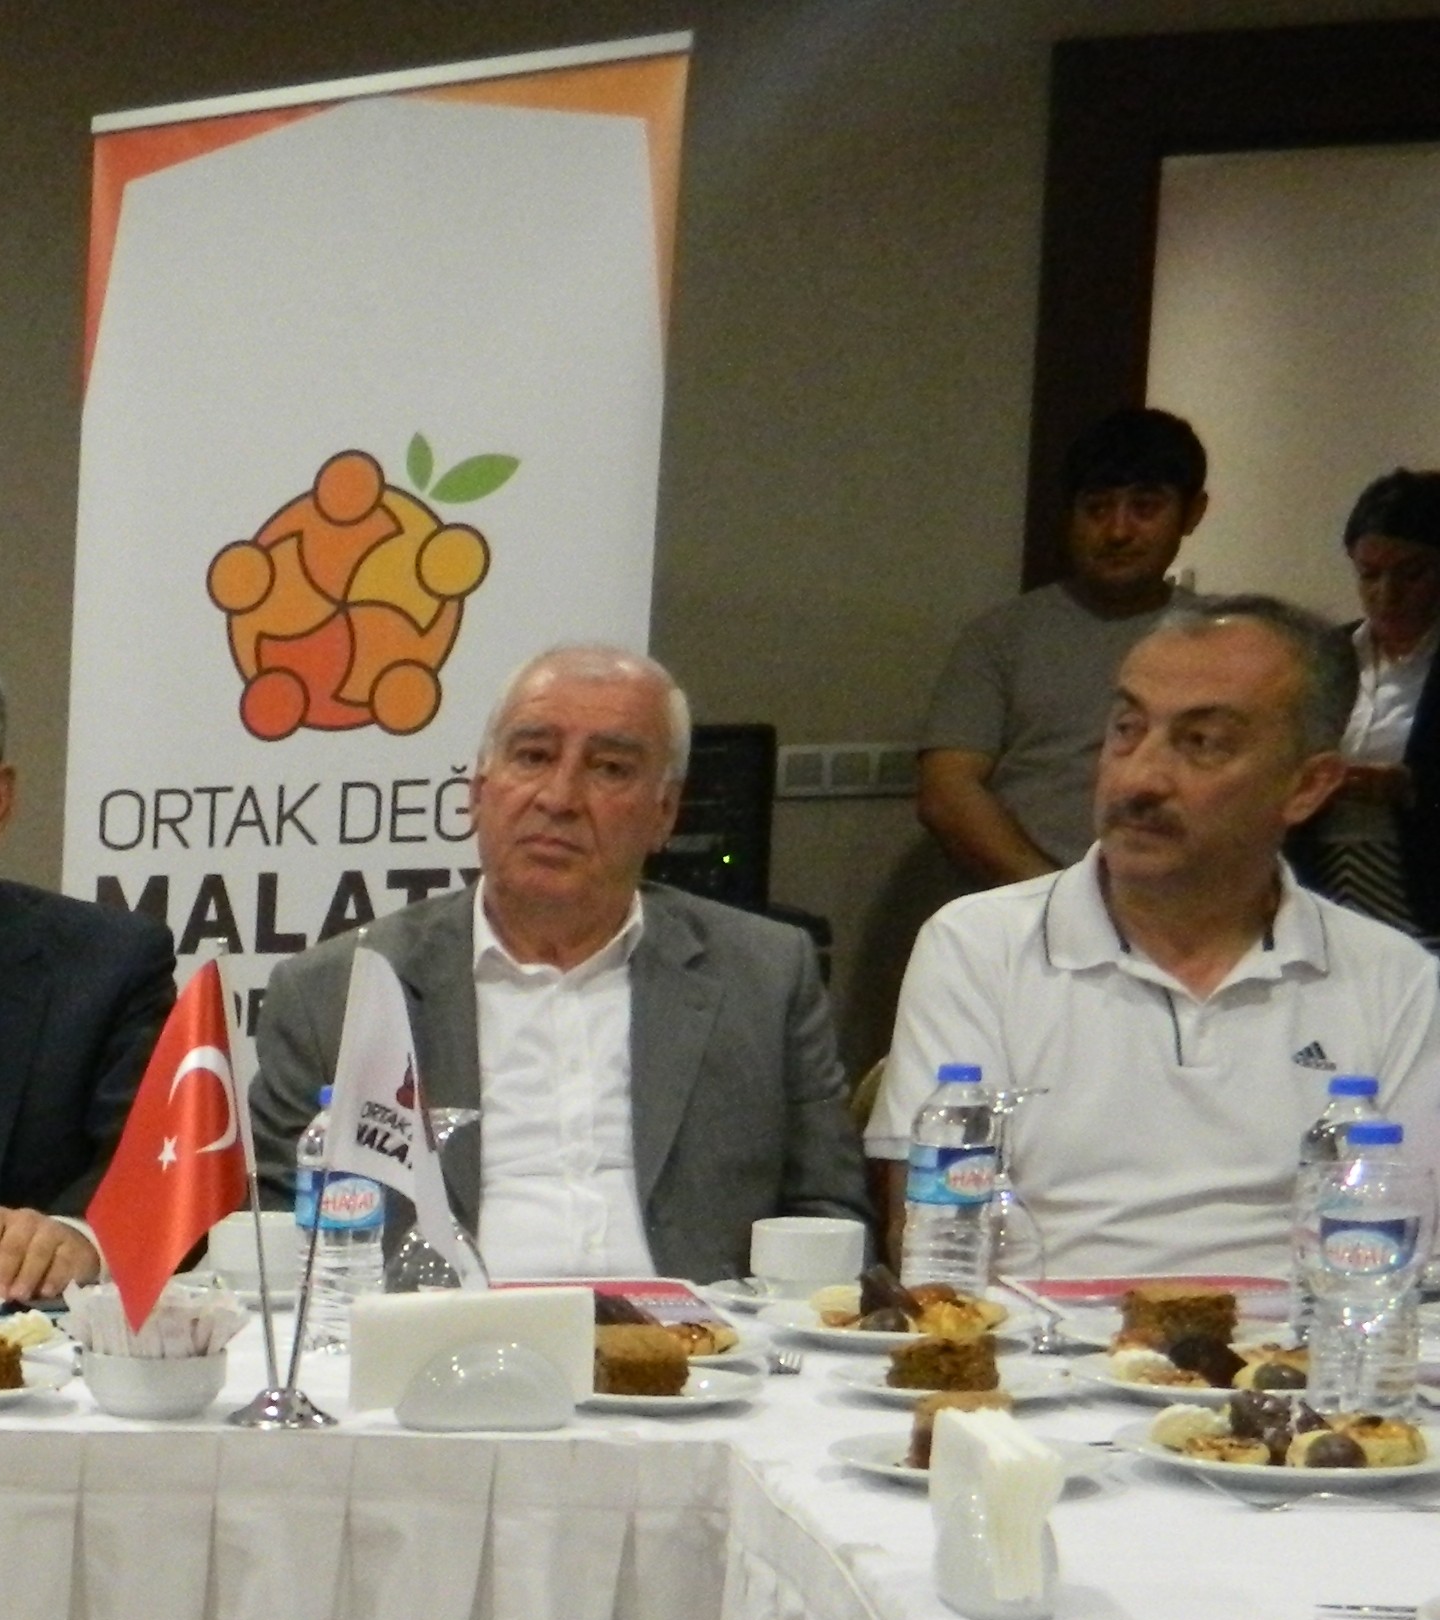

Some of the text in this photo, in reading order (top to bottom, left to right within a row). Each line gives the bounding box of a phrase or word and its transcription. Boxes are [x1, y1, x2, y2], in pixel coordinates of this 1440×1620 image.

[99, 765, 476, 851] ORTAK DEĞ
[95, 867, 483, 955] MALAT
